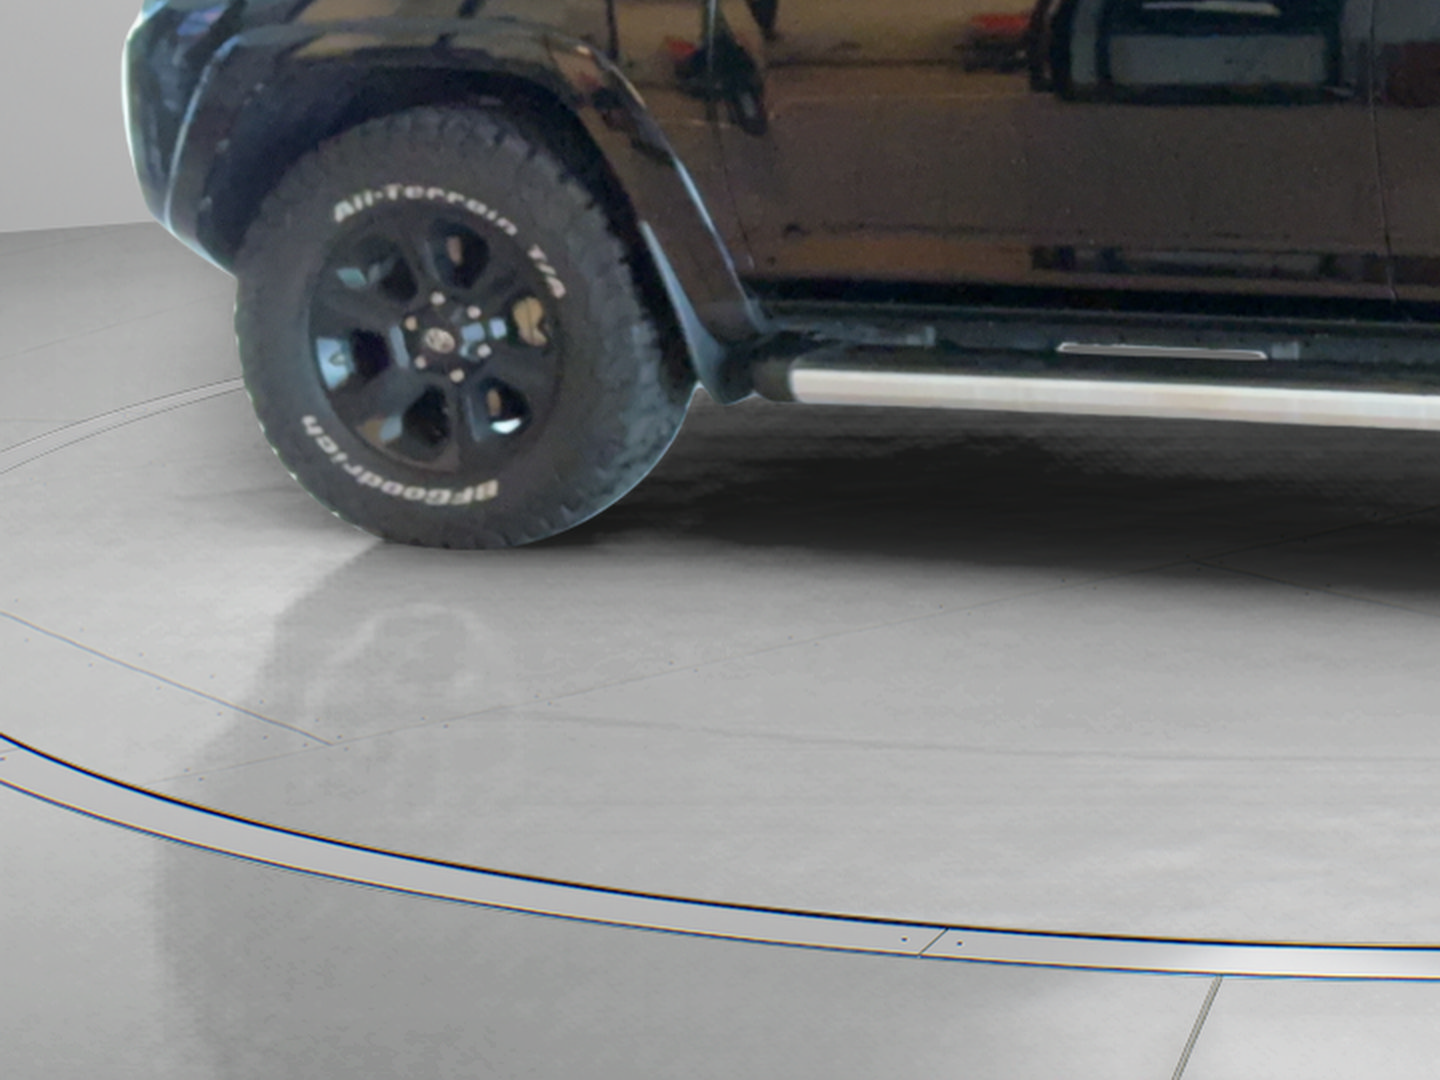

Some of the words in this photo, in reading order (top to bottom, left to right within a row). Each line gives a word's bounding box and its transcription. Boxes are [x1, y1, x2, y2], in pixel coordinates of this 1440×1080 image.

[332, 183, 518, 237] All-Terrain
[528, 244, 567, 299] T/A
[301, 415, 499, 507] BFGoodrich
